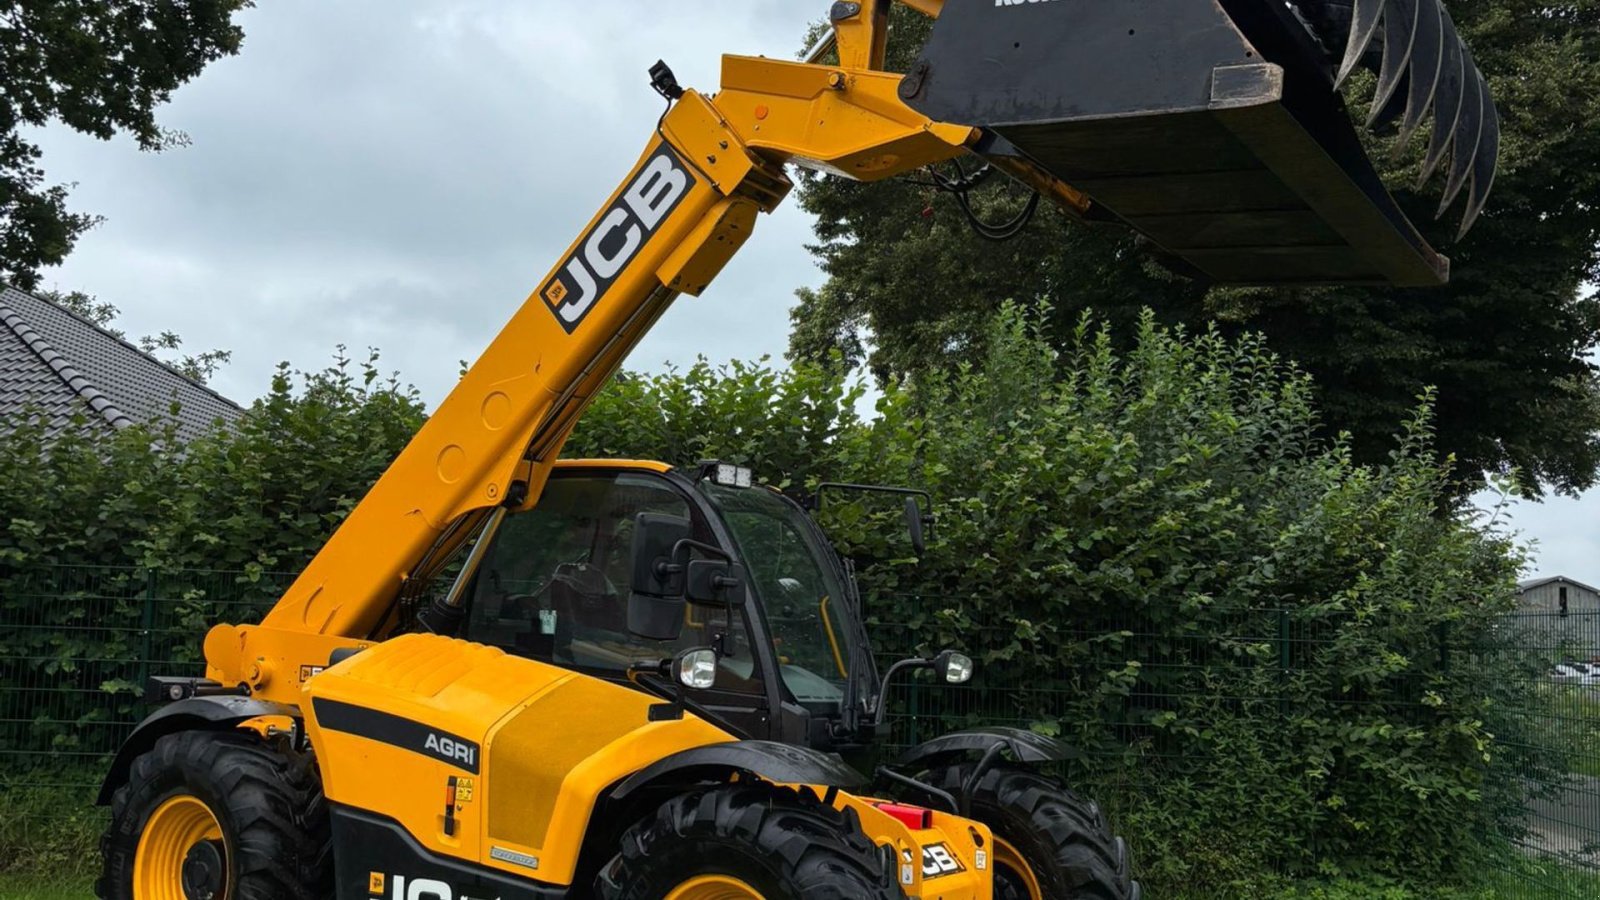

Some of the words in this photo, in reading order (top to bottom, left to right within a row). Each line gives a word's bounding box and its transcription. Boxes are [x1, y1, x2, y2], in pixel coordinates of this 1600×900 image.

[558, 155, 686, 322] JCB
[424, 733, 474, 765] AGRI
[907, 846, 959, 875] CB
